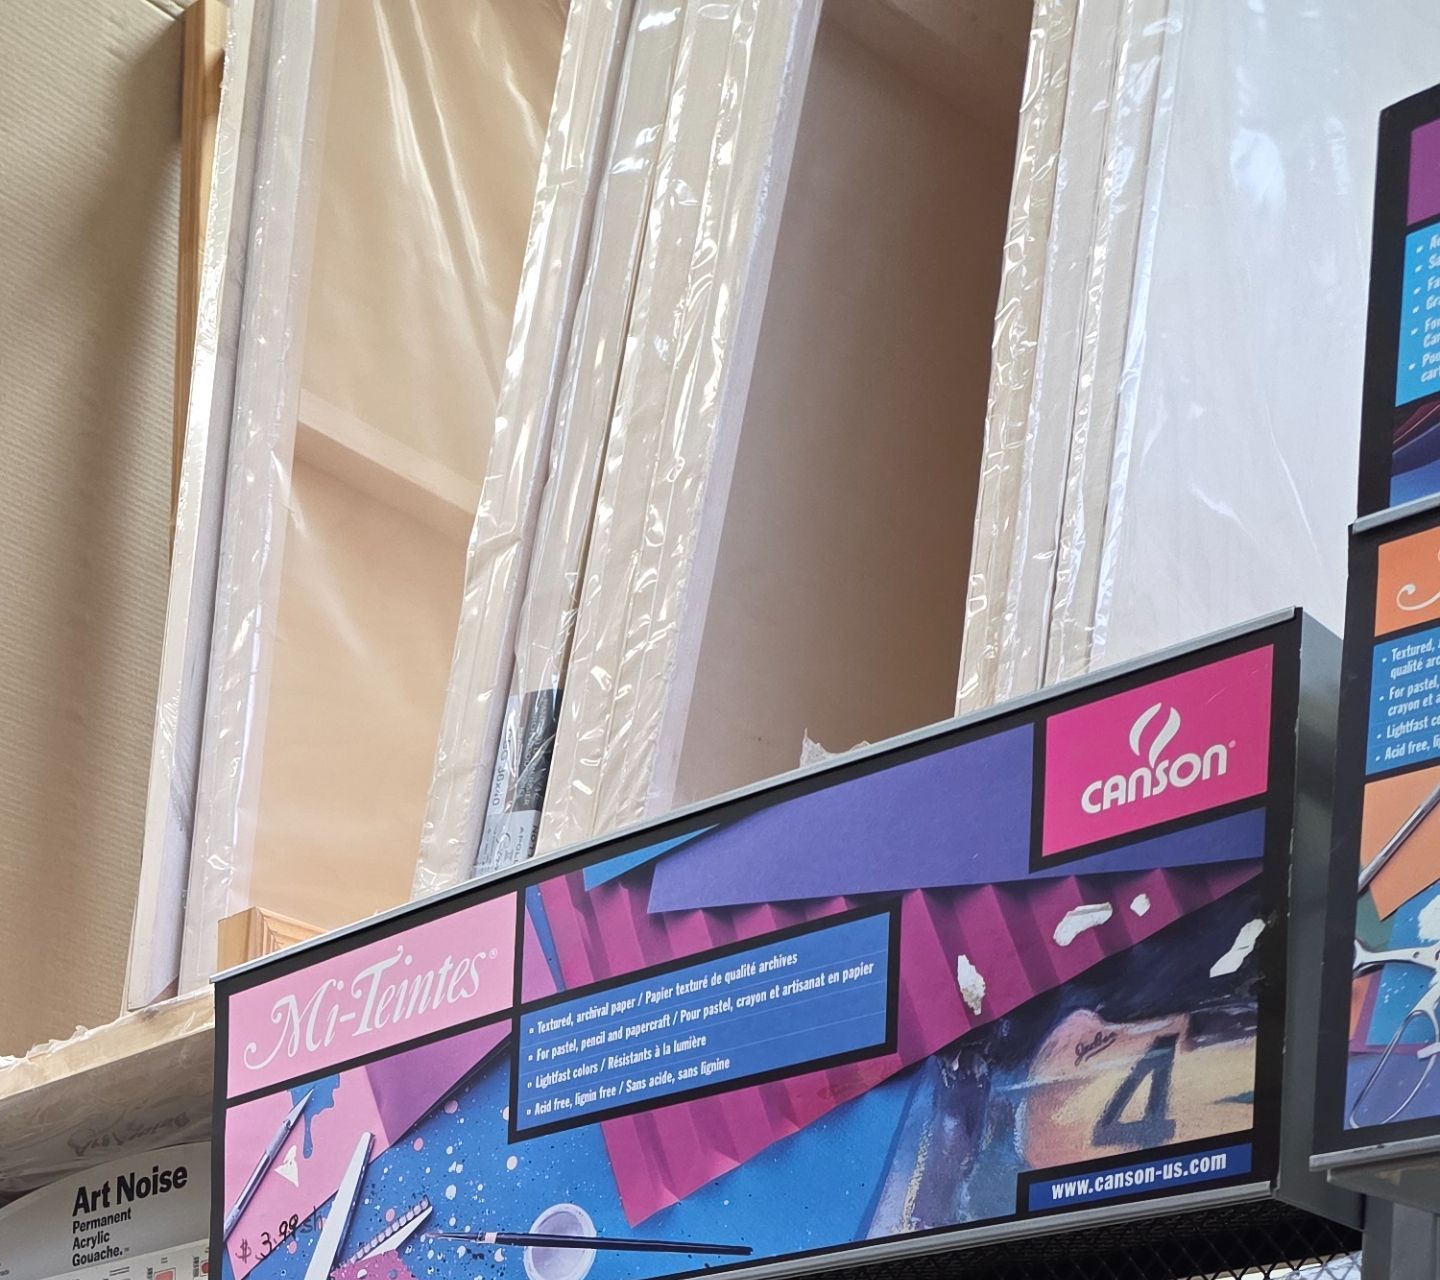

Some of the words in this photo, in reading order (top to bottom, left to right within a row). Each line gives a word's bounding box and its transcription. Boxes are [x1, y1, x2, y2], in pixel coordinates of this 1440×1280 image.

[1391, 639, 1435, 662] Textured,
[1390, 657, 1423, 679] qualité
[1389, 685, 1405, 700] For
[1388, 697, 1420, 717] crayon
[1422, 697, 1433, 709] et
[1387, 716, 1428, 739] Lightfast
[1385, 743, 1405, 761] Acid
[1408, 739, 1430, 756] free,
[537, 1013, 574, 1034] Textured,
[577, 1002, 608, 1024] archival
[611, 998, 636, 1018] paper
[646, 987, 673, 1005] Papier
[676, 975, 708, 998] texturé
[711, 972, 722, 987] de
[725, 963, 756, 984] qualité
[759, 952, 798, 974] archives
[243, 945, 487, 1070] Mi-Teintes
[536, 1048, 549, 1062] For
[552, 1039, 579, 1061] pastel,
[581, 1030, 605, 1052] pencil
[608, 1026, 623, 1044] and
[626, 1014, 671, 1038] papercraft
[681, 1008, 700, 1023] Pour
[704, 998, 734, 1021] pastel,
[737, 991, 766, 1011] crayon
[770, 985, 779, 999] et
[782, 974, 825, 998] artisanat
[828, 971, 839, 984] en
[843, 961, 874, 986] papier
[535, 1067, 571, 1089] Lightfast
[573, 1061, 598, 1081] colors
[608, 1046, 652, 1070] Résistants
[663, 1042, 671, 1056] la
[673, 1034, 706, 1053] lumière
[535, 1099, 551, 1116] Acid
[554, 1094, 572, 1112] free,
[575, 1086, 596, 1107] lignin
[599, 1082, 616, 1099] free
[626, 1077, 646, 1094] Sans
[649, 1071, 674, 1089] acide,
[678, 1065, 698, 1081] sans
[701, 1057, 730, 1076] lignine
[1052, 1153, 1226, 1200] www.canson-us.com
[72, 1180, 111, 1217] Art
[117, 1166, 187, 1203] Noise
[72, 1208, 131, 1234] Permanent
[72, 1231, 110, 1250] Acrylic
[72, 1247, 123, 1267] Gouache.
